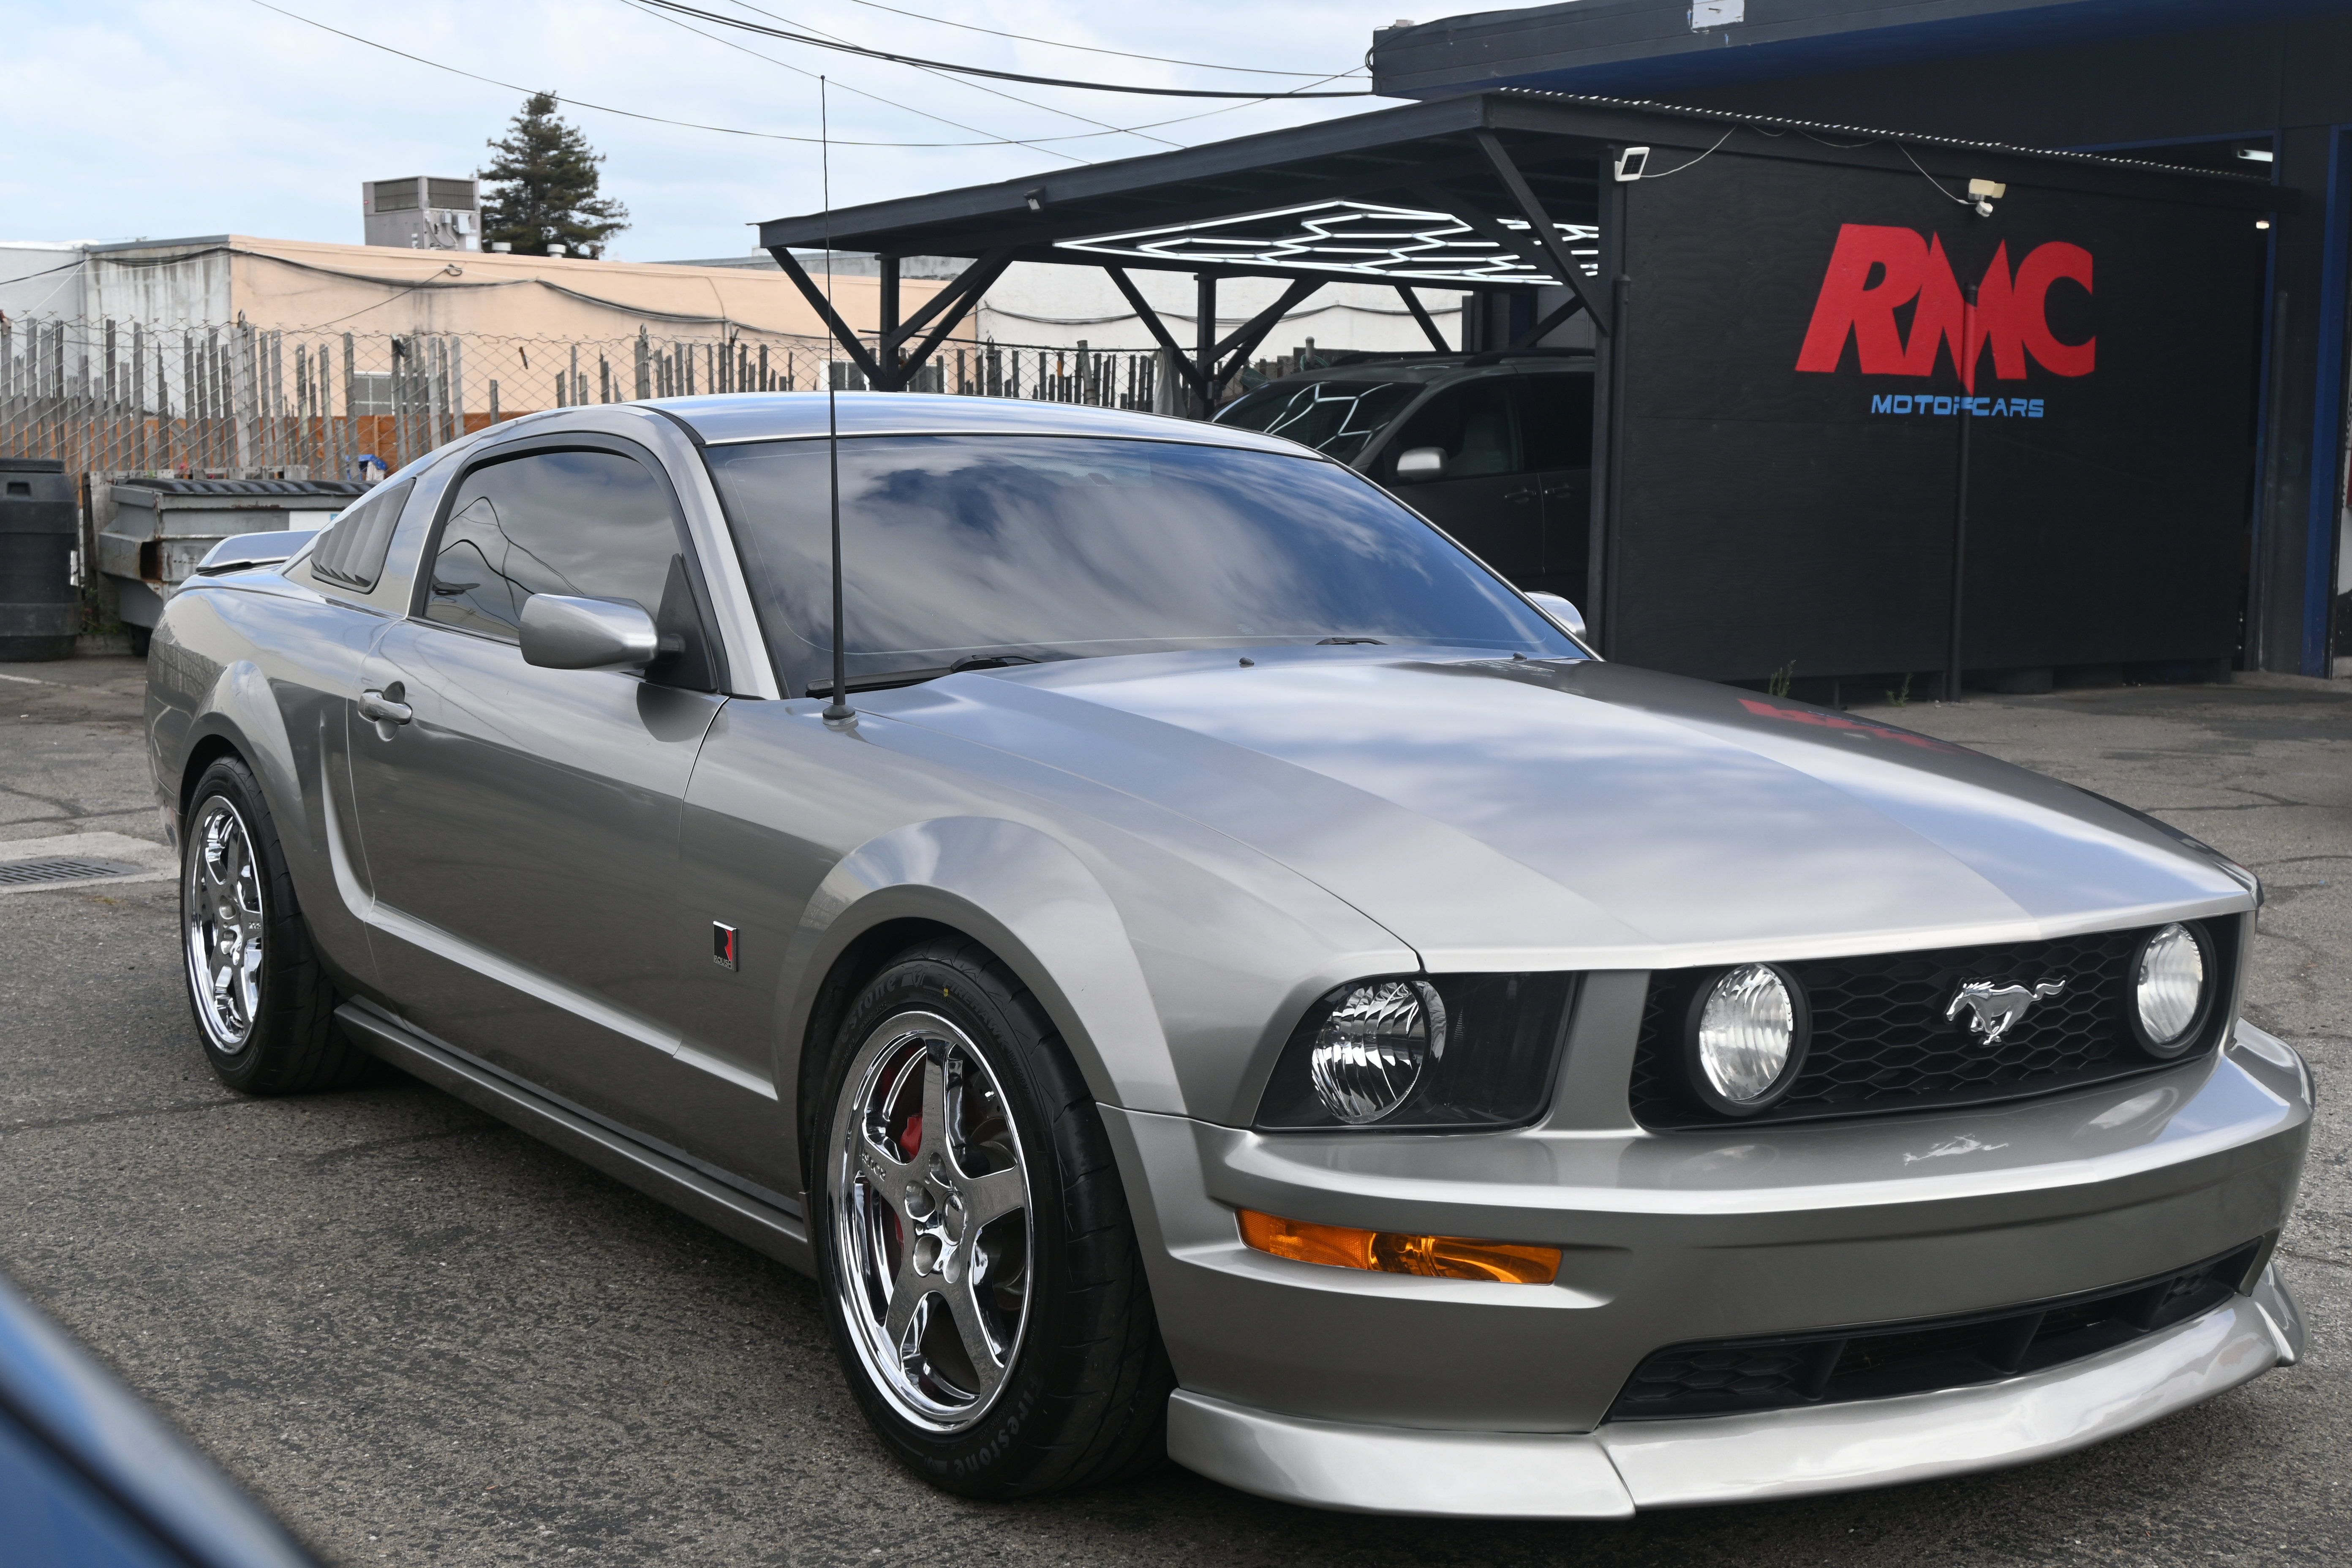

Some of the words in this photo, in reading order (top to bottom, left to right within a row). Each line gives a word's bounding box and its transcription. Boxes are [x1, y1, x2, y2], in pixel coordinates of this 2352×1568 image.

[1795, 223, 2096, 396] RMC
[713, 955, 732, 969] ROUSH
[942, 978, 1009, 1050] FIREHAWK
[954, 1374, 1044, 1477] Firestone
